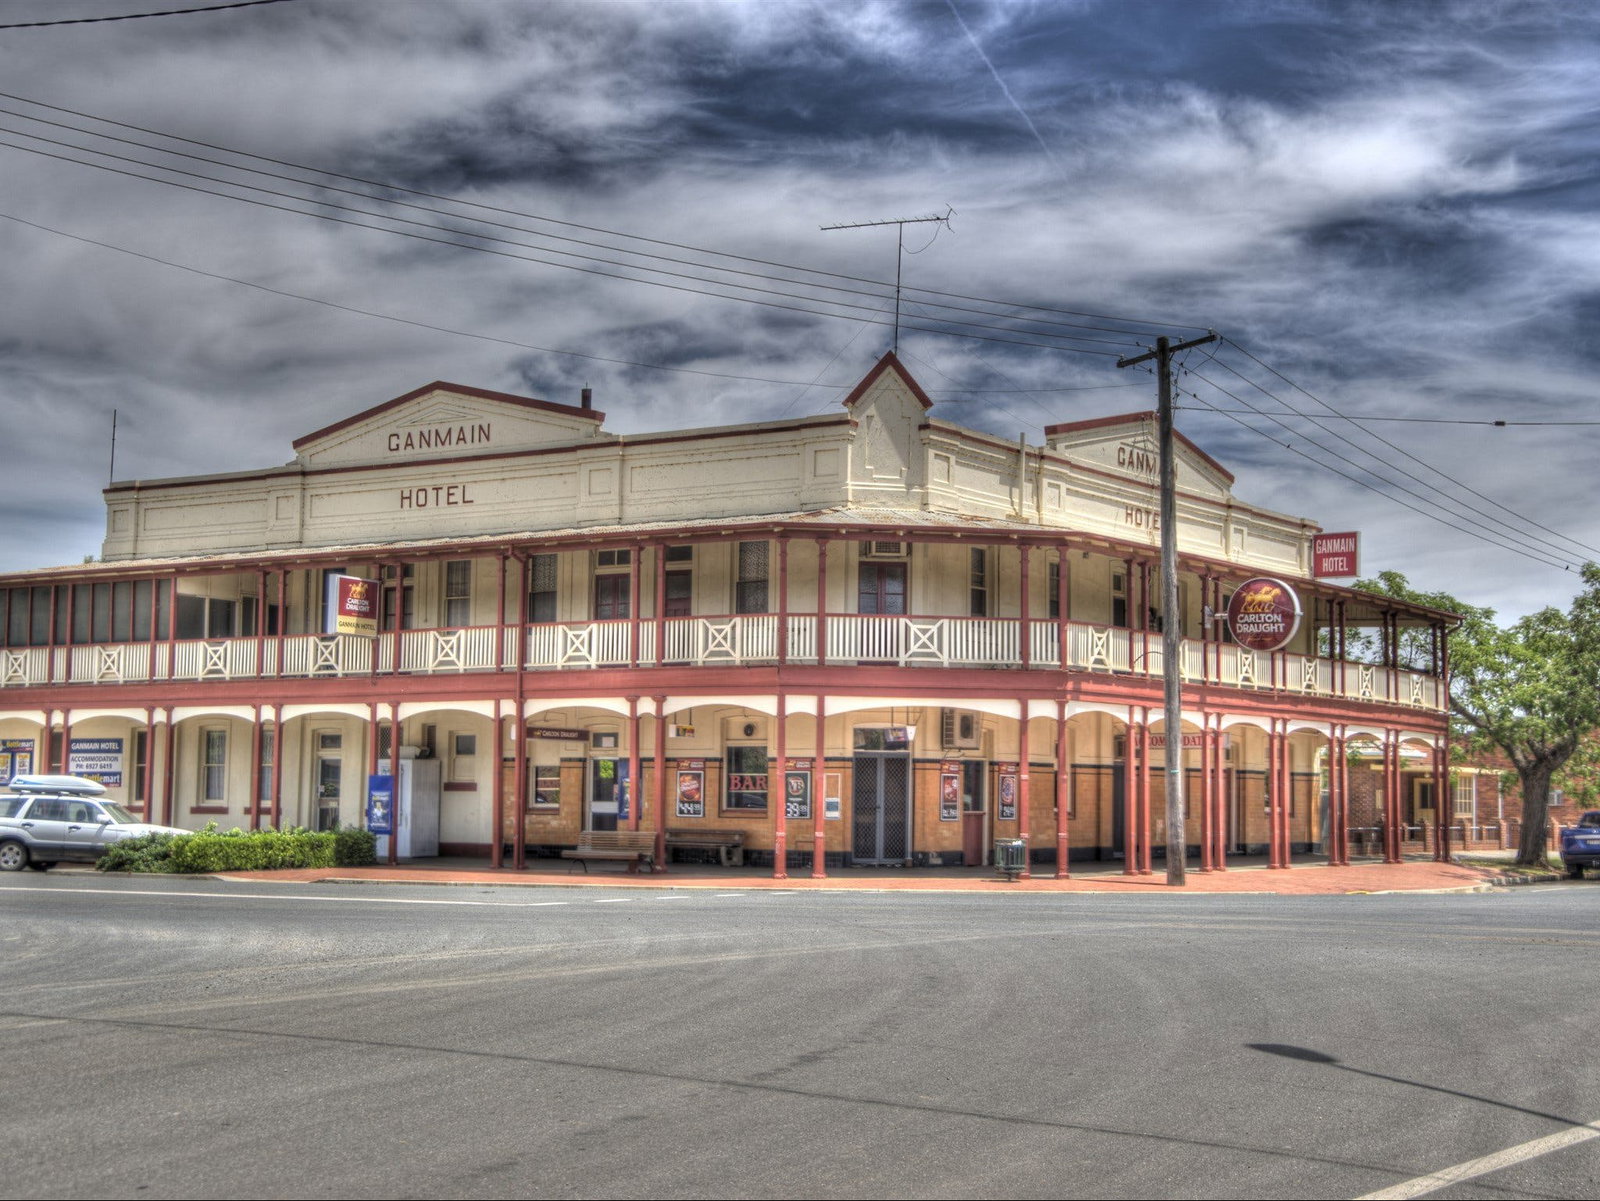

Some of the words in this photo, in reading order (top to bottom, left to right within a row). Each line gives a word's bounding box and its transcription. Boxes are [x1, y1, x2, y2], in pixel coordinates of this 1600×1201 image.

[388, 423, 490, 452] GANMAIN
[400, 485, 474, 509] HOTEL
[1125, 505, 1161, 531] HOTE
[1315, 537, 1355, 554] GANMAIN
[1322, 557, 1349, 572] HOTEL
[345, 602, 370, 612] DRAUGHT
[347, 598, 369, 606] CARLTON
[1237, 613, 1282, 623] CARLTON
[338, 621, 360, 629] GANMAIN
[1236, 623, 1286, 633] DRAUGHT
[71, 742, 99, 750] GANMAIN
[100, 742, 119, 750] HOTEL
[70, 755, 119, 763] ACCOMMODATION
[729, 775, 768, 791] BAR
